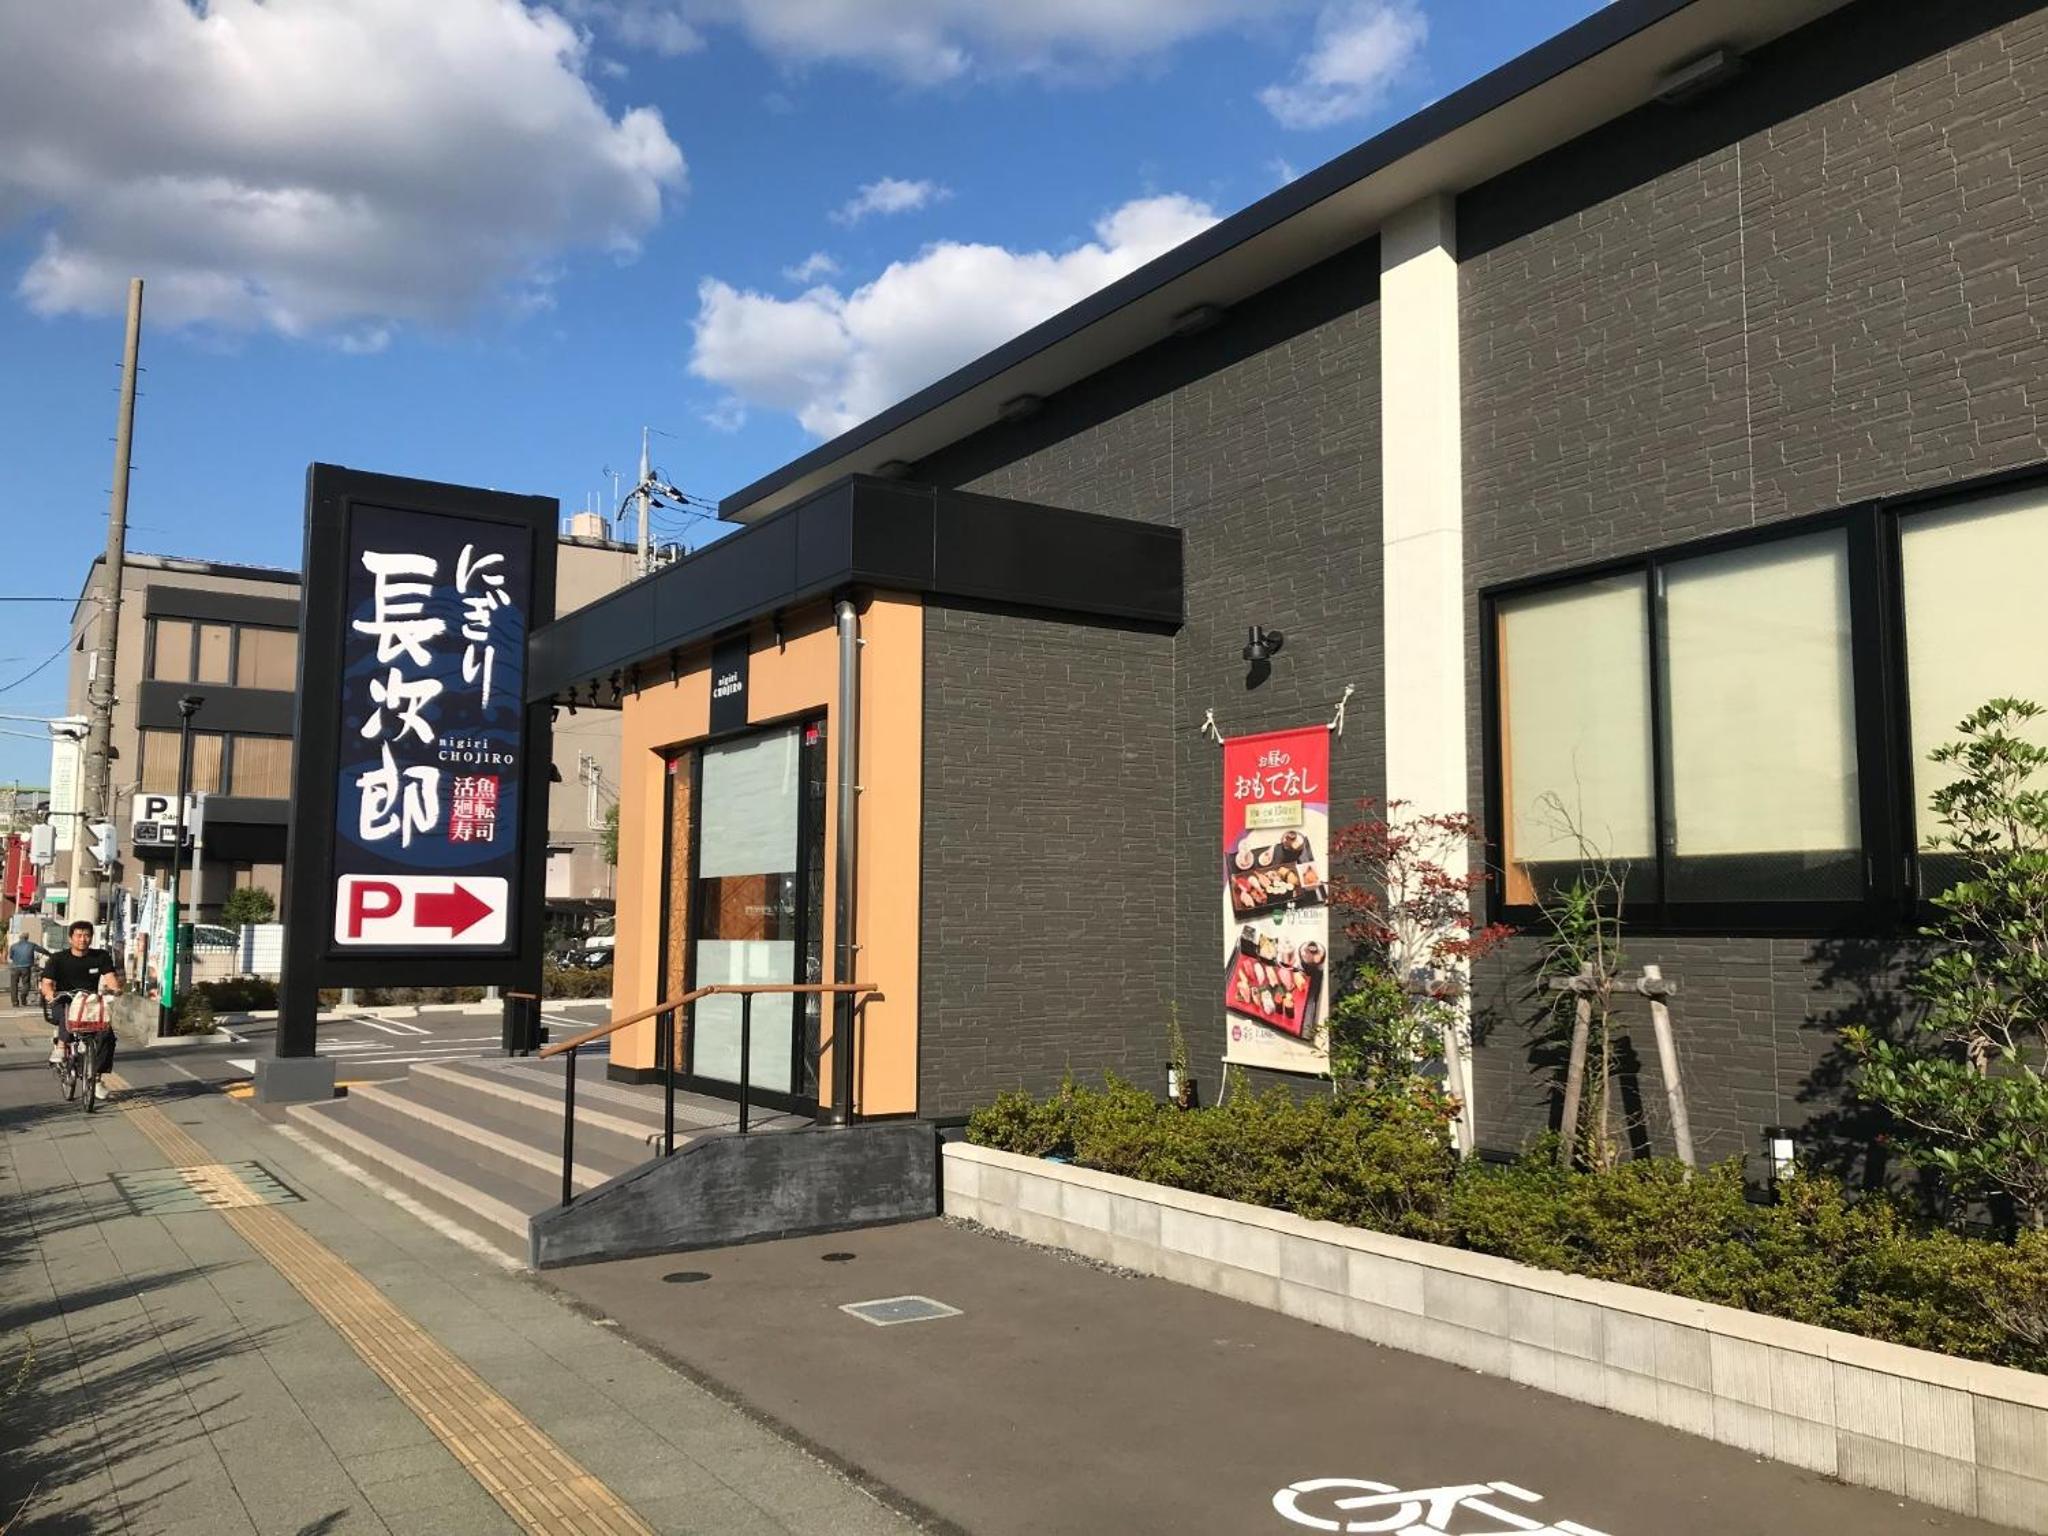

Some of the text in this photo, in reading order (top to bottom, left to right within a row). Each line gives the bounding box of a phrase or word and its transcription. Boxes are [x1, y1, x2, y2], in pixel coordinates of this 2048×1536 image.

[455, 543, 511, 710] にぎり
[351, 550, 446, 849] 長次郎
[713, 681, 743, 698] CHOJIRO
[439, 736, 489, 749] nigiri
[438, 750, 514, 765] CHOJIRO
[1258, 749, 1290, 768] お昼の
[1233, 767, 1319, 799] おもてなし
[145, 797, 168, 819] P
[347, 881, 403, 938] P
